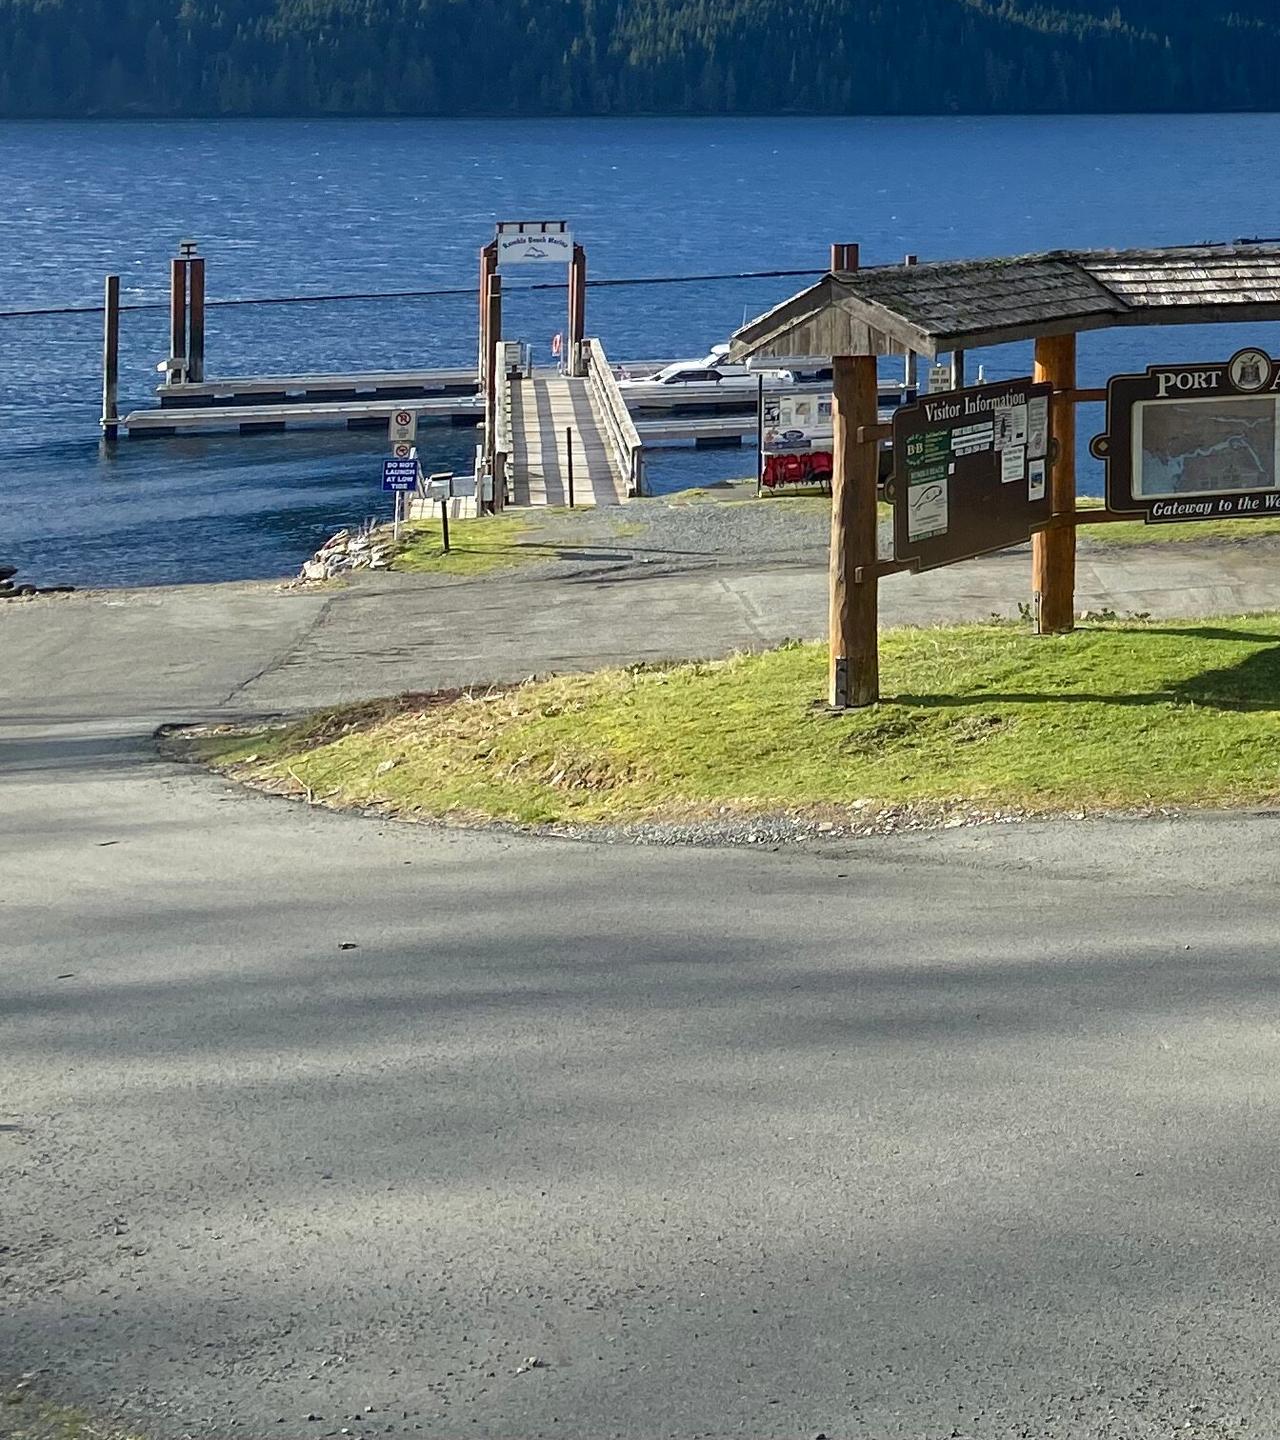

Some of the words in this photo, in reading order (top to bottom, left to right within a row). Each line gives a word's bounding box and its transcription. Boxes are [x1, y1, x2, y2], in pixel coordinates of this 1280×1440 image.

[548, 237, 568, 248] Marina
[1156, 371, 1221, 397] PORT
[925, 401, 960, 422] Visitor
[965, 388, 1026, 415] Information
[1153, 502, 1212, 516] Gateway
[1219, 499, 1232, 511] to
[1238, 497, 1259, 510] the
